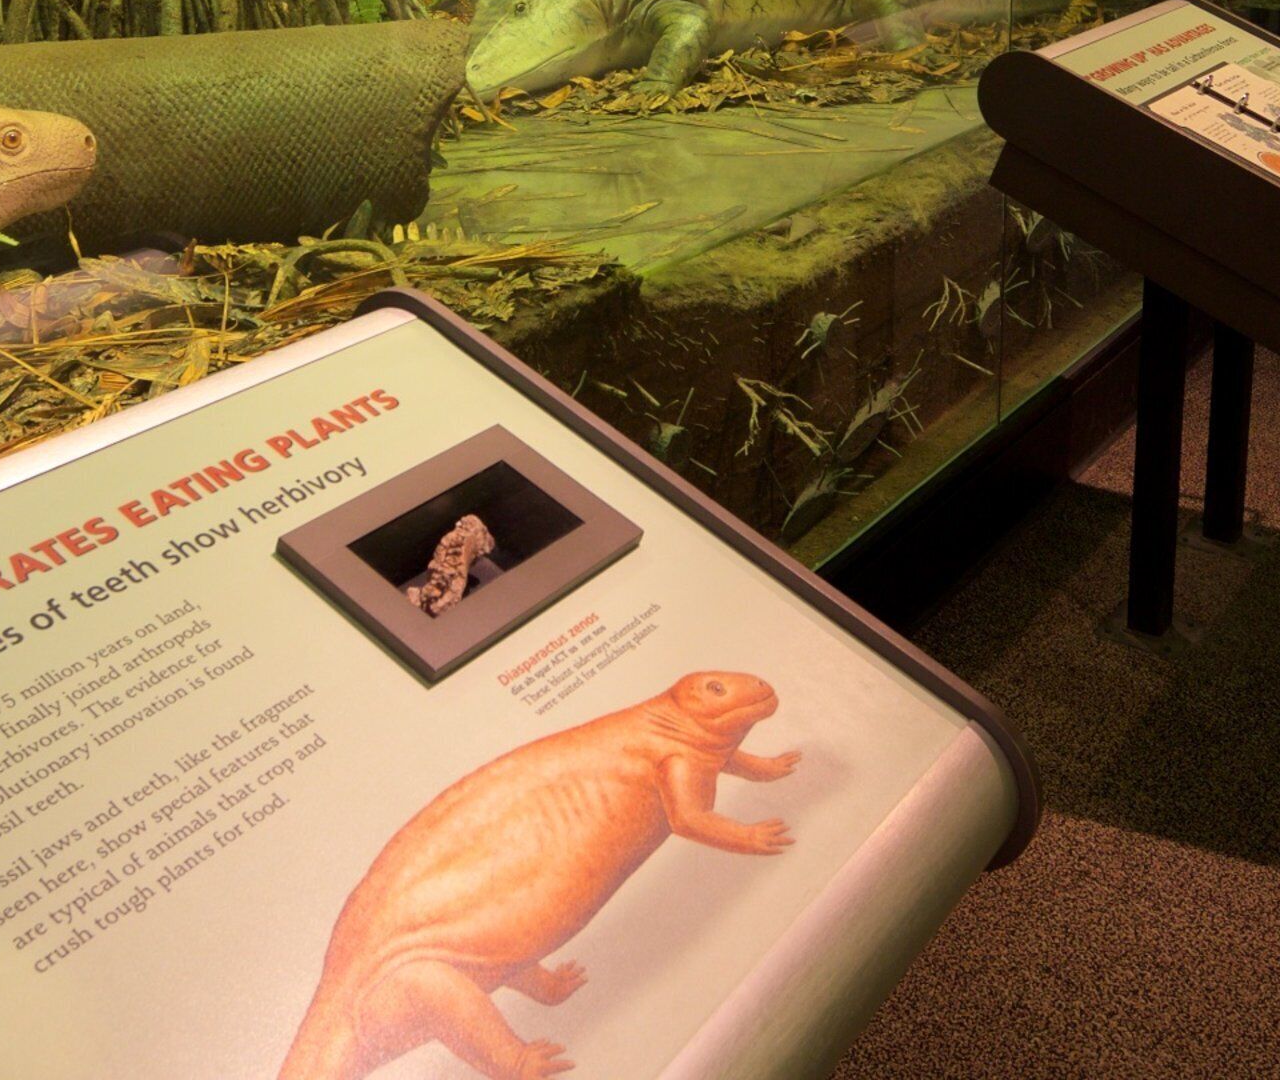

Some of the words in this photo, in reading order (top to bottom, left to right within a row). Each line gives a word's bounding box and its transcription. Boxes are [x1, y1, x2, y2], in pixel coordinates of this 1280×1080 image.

[118, 448, 271, 528] EATING
[266, 388, 400, 458] PLANTS
[30, 598, 68, 632] of
[70, 559, 159, 609] teeth
[161, 517, 241, 566] show
[238, 456, 368, 525] herbivory
[0, 700, 61, 739] finally
[62, 665, 121, 708] joined
[122, 618, 212, 672] arthropods
[20, 661, 85, 700] million
[86, 635, 133, 668] years
[135, 623, 158, 640] on
[155, 599, 202, 626] land,
[80, 695, 124, 720] The
[125, 654, 198, 699] evidence
[195, 638, 223, 659] for
[90, 685, 189, 747] innovation
[188, 676, 206, 691] is
[203, 645, 255, 680] found
[497, 635, 569, 687] Diasparactus
[568, 611, 600, 638] zenos
[520, 684, 551, 706] These
[548, 666, 574, 687] blunt
[573, 641, 610, 669] sideways
[609, 615, 641, 643] oriented
[639, 603, 661, 621] teeth
[535, 697, 559, 716] were
[557, 676, 584, 700] suited
[581, 669, 597, 682] for
[551, 650, 568, 667] ACT
[25, 778, 85, 817] teeth.
[30, 828, 83, 868] jaws
[84, 800, 123, 832] and
[122, 771, 180, 807] teeth,
[174, 748, 212, 773] like
[211, 728, 242, 751] the
[239, 682, 315, 733] fragment
[39, 858, 96, 893] here,
[96, 819, 147, 859] show
[151, 776, 212, 823] special
[208, 735, 280, 783] features
[278, 712, 315, 739] that
[12, 922, 48, 950] are
[48, 869, 121, 924] typical
[122, 852, 145, 877] of
[145, 807, 218, 861] animals
[217, 781, 256, 812] that
[257, 757, 295, 786] crop
[295, 732, 327, 761] and
[33, 926, 95, 973] crush
[94, 885, 156, 931] tough
[156, 843, 215, 892] plants
[212, 822, 244, 848] for
[241, 792, 291, 828] food.
